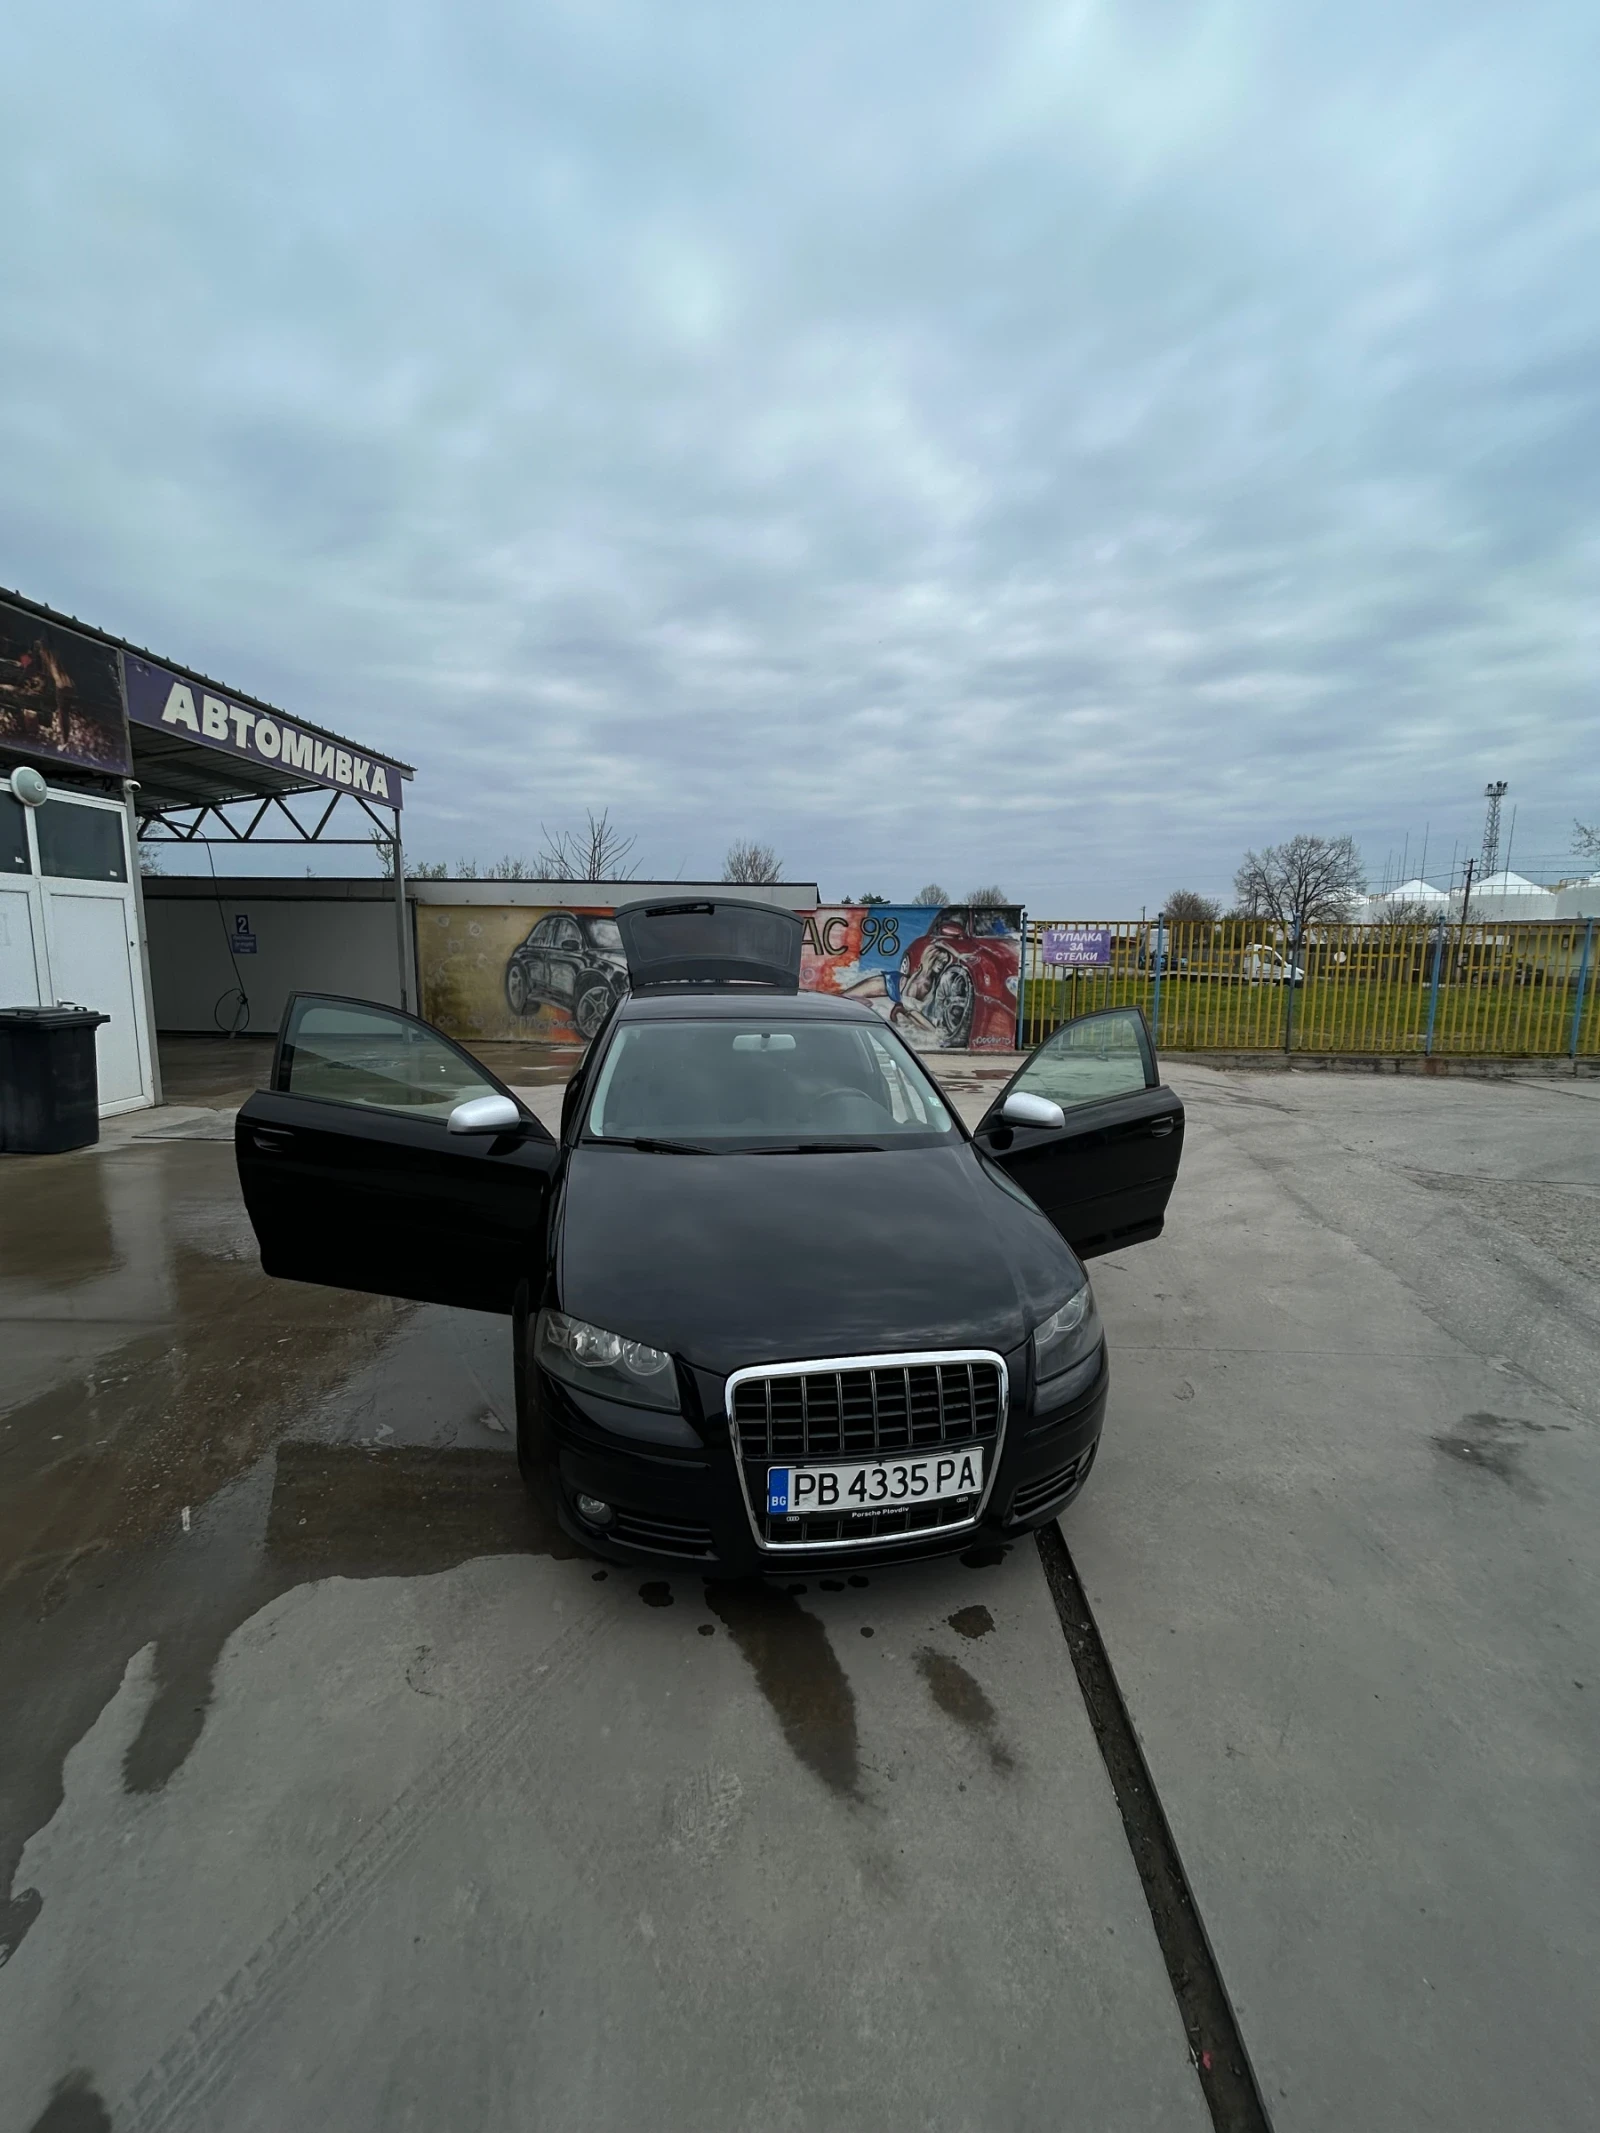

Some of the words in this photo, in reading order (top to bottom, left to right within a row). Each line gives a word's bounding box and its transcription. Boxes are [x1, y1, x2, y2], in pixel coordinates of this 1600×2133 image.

[161, 682, 390, 799] АВТОМИВКА
[238, 917, 248, 933] 2
[860, 917, 900, 957] 98
[1052, 932, 1103, 942] ТУПАЛКА
[1069, 942, 1084, 951] ЗА
[1055, 952, 1098, 961] СТЕЛКИ
[794, 1473, 840, 1507] PB
[848, 1463, 929, 1503] 4335
[936, 1455, 976, 1493] PA
[771, 1496, 787, 1507] BG
[852, 1510, 881, 1518] Porsche
[882, 1506, 910, 1515] Plovdiv
